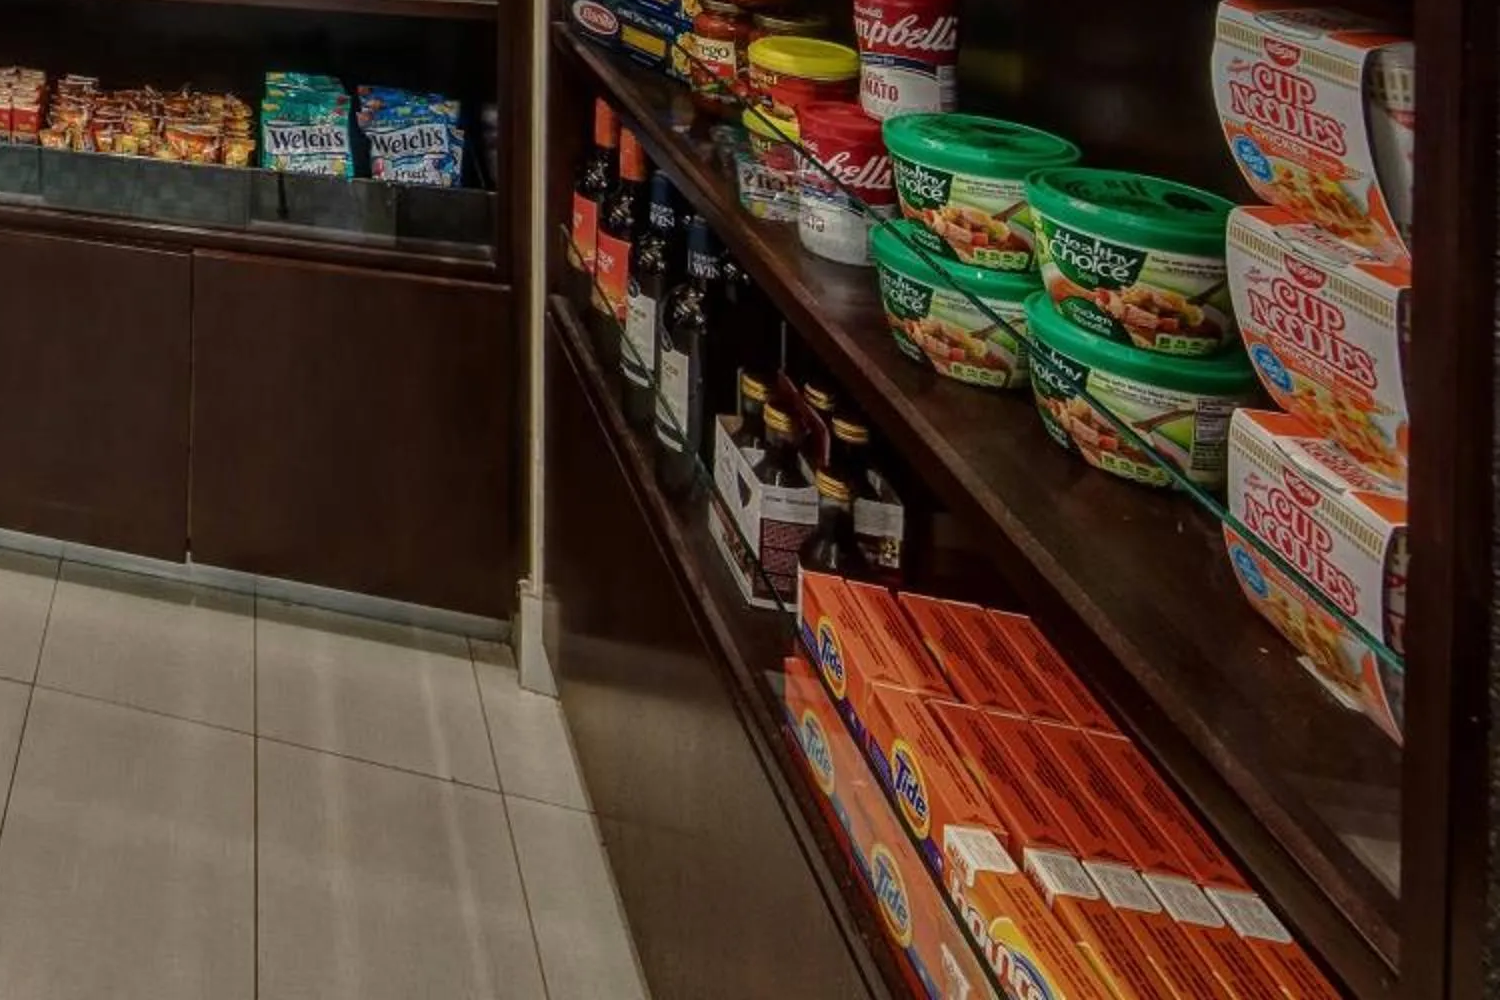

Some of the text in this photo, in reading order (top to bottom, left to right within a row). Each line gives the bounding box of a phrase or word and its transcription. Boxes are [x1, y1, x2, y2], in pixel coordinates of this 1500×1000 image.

[854, 14, 960, 51] mpbell's
[864, 77, 900, 101] MATO
[1251, 61, 1317, 107] CUP
[271, 125, 345, 150] Welch's
[367, 127, 444, 153] Welch's
[1229, 80, 1347, 157] NOODLES
[1050, 240, 1130, 282] Choice
[1053, 227, 1139, 268] Healthy
[1272, 278, 1346, 332] CUP
[1248, 288, 1378, 390] NOODLES
[1268, 488, 1333, 554] CUP
[1243, 493, 1359, 617] NOODLES
[820, 629, 844, 682] Tide
[804, 720, 832, 778] Tide
[894, 752, 928, 818] Tide
[875, 853, 908, 925] Tide
